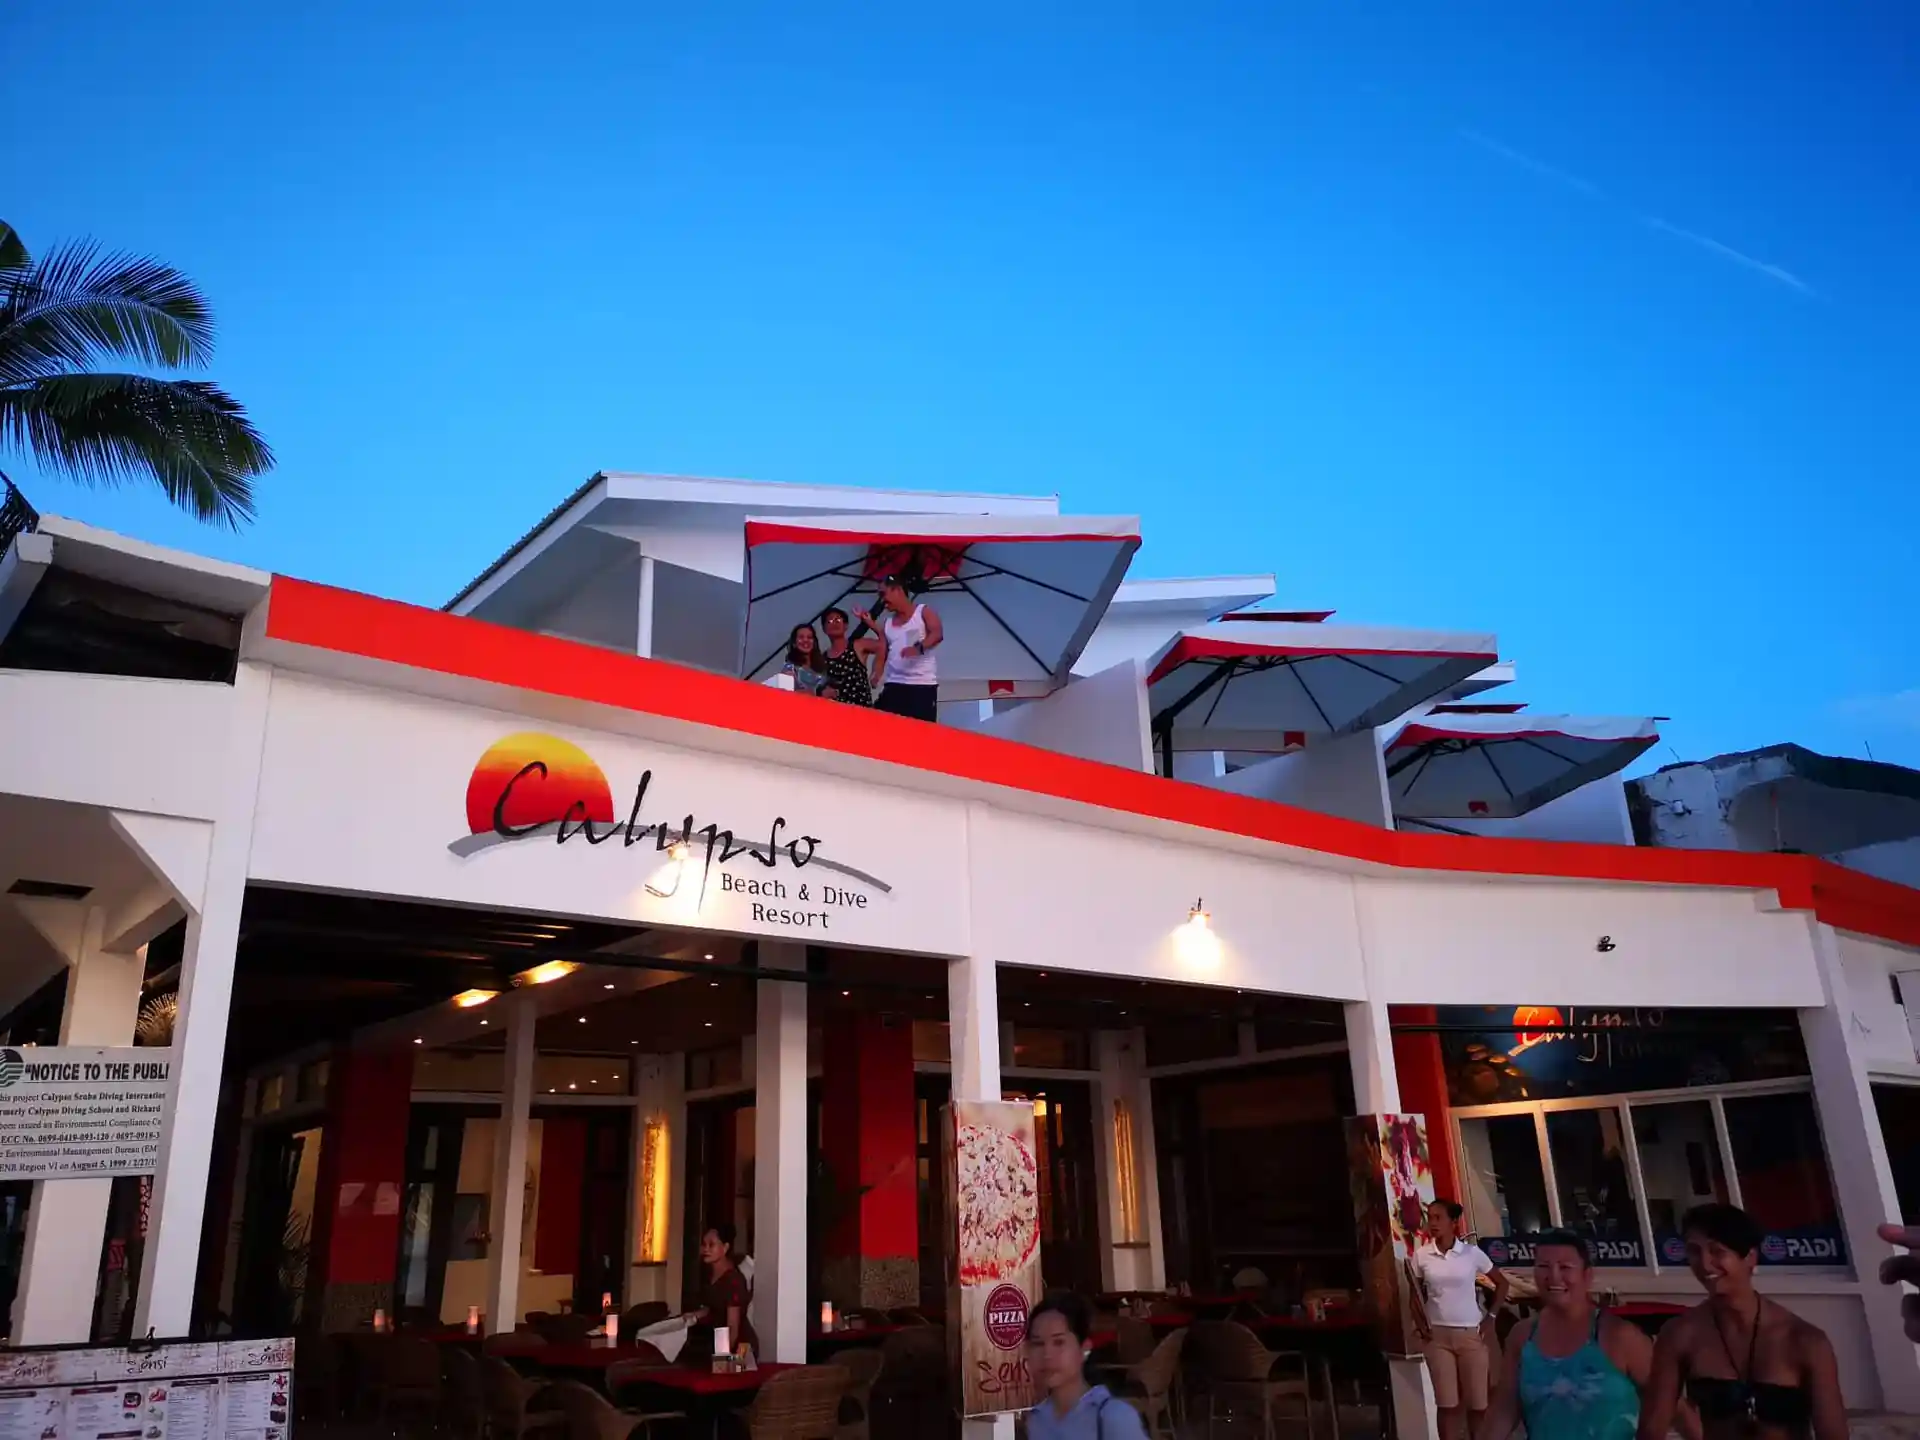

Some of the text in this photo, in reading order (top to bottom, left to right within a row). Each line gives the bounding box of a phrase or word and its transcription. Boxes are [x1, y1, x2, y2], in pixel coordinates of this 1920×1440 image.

[494, 760, 822, 913] Calypso
[721, 873, 869, 909] Beach & Dive
[752, 903, 829, 929] Resort
[84, 1063, 101, 1080] TO
[105, 1063, 130, 1080] THE
[133, 1062, 169, 1080] PUBLI
[12, 1092, 38, 1104] project
[41, 1091, 72, 1104] Calypso
[74, 1091, 97, 1101] Scuba
[99, 1091, 124, 1102] Diving
[28, 1106, 60, 1117] Calypso
[61, 1105, 87, 1116] Diving
[88, 1104, 114, 1114] School
[115, 1104, 130, 1113] and
[131, 1104, 161, 1113] Richard
[54, 1119, 107, 1129] Environmental
[109, 1117, 150, 1128] Compliance
[1, 1134, 20, 1144] ECC
[22, 1134, 35, 1143] No.
[115, 1145, 140, 1154] Bureau
[141, 1143, 157, 1155] (EM
[0, 1162, 17, 1173] ENR
[19, 1162, 46, 1173] Region
[70, 1160, 98, 1172] August
[110, 1158, 127, 1168] 1999
[1598, 1241, 1640, 1260] PADI
[1786, 1237, 1838, 1258] PADI
[989, 1310, 1026, 1325] PIZZA
